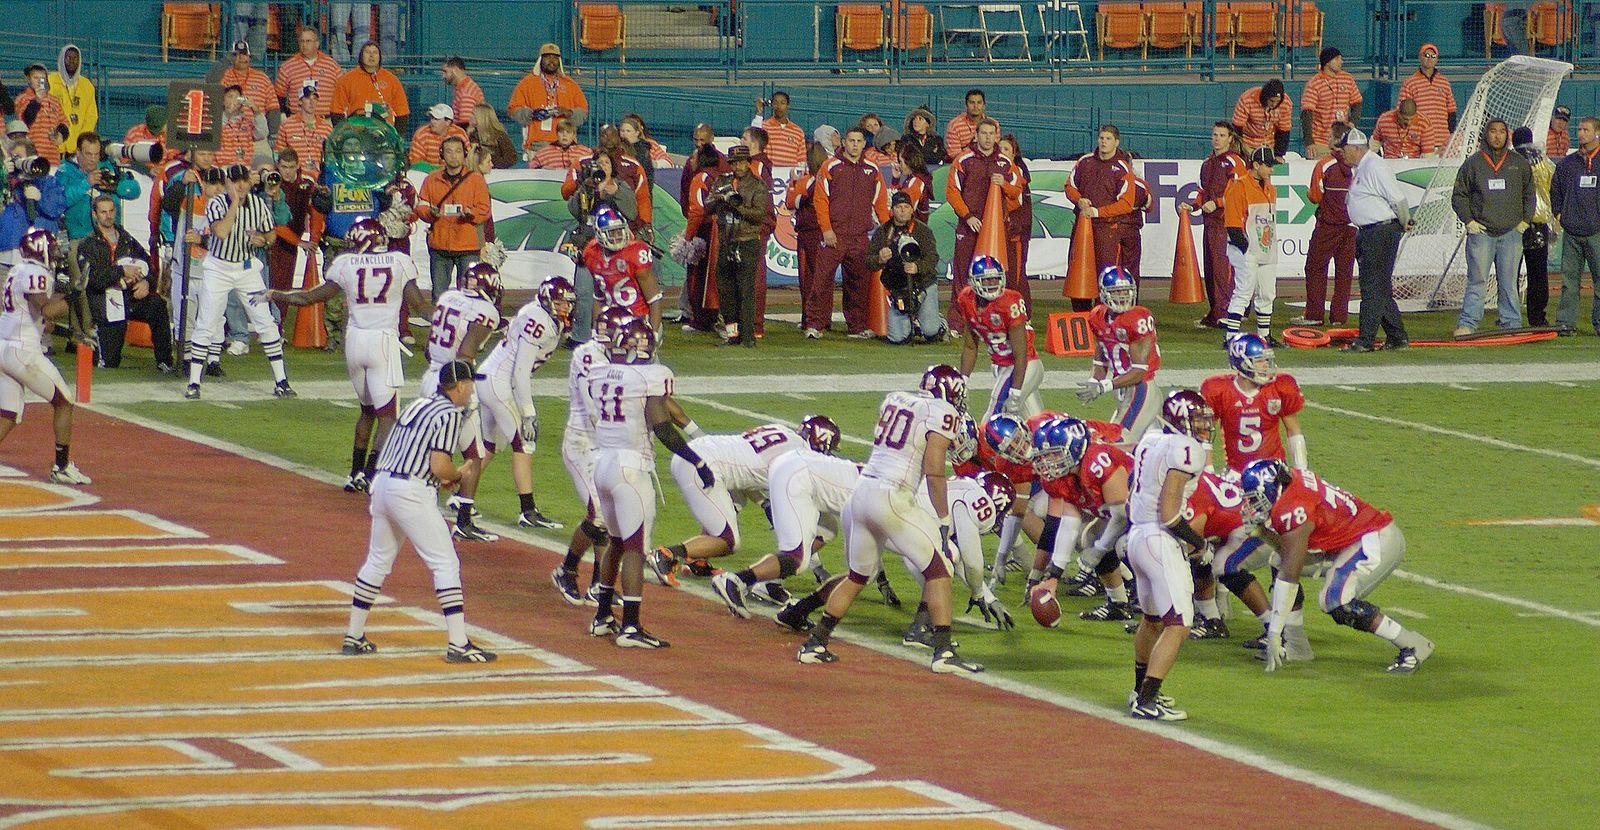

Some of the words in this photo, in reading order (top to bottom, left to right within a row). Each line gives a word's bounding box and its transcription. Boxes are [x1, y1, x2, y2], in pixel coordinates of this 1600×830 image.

[185, 90, 203, 134] 1
[350, 255, 395, 266] CHANCELLOR
[29, 274, 47, 291] 18
[356, 266, 393, 304] 17
[429, 304, 460, 350] 25
[523, 318, 545, 340] 26
[1057, 316, 1088, 351] 10
[1137, 315, 1155, 335] 80
[600, 383, 626, 422] 11
[874, 404, 915, 450] 90
[942, 413, 962, 434] 90
[1063, 423, 1086, 449] KU
[1237, 416, 1263, 454] 5
[1090, 452, 1112, 479] 50
[1184, 446, 1191, 465] 1
[972, 496, 993, 522] 99
[1280, 507, 1308, 531] 78
